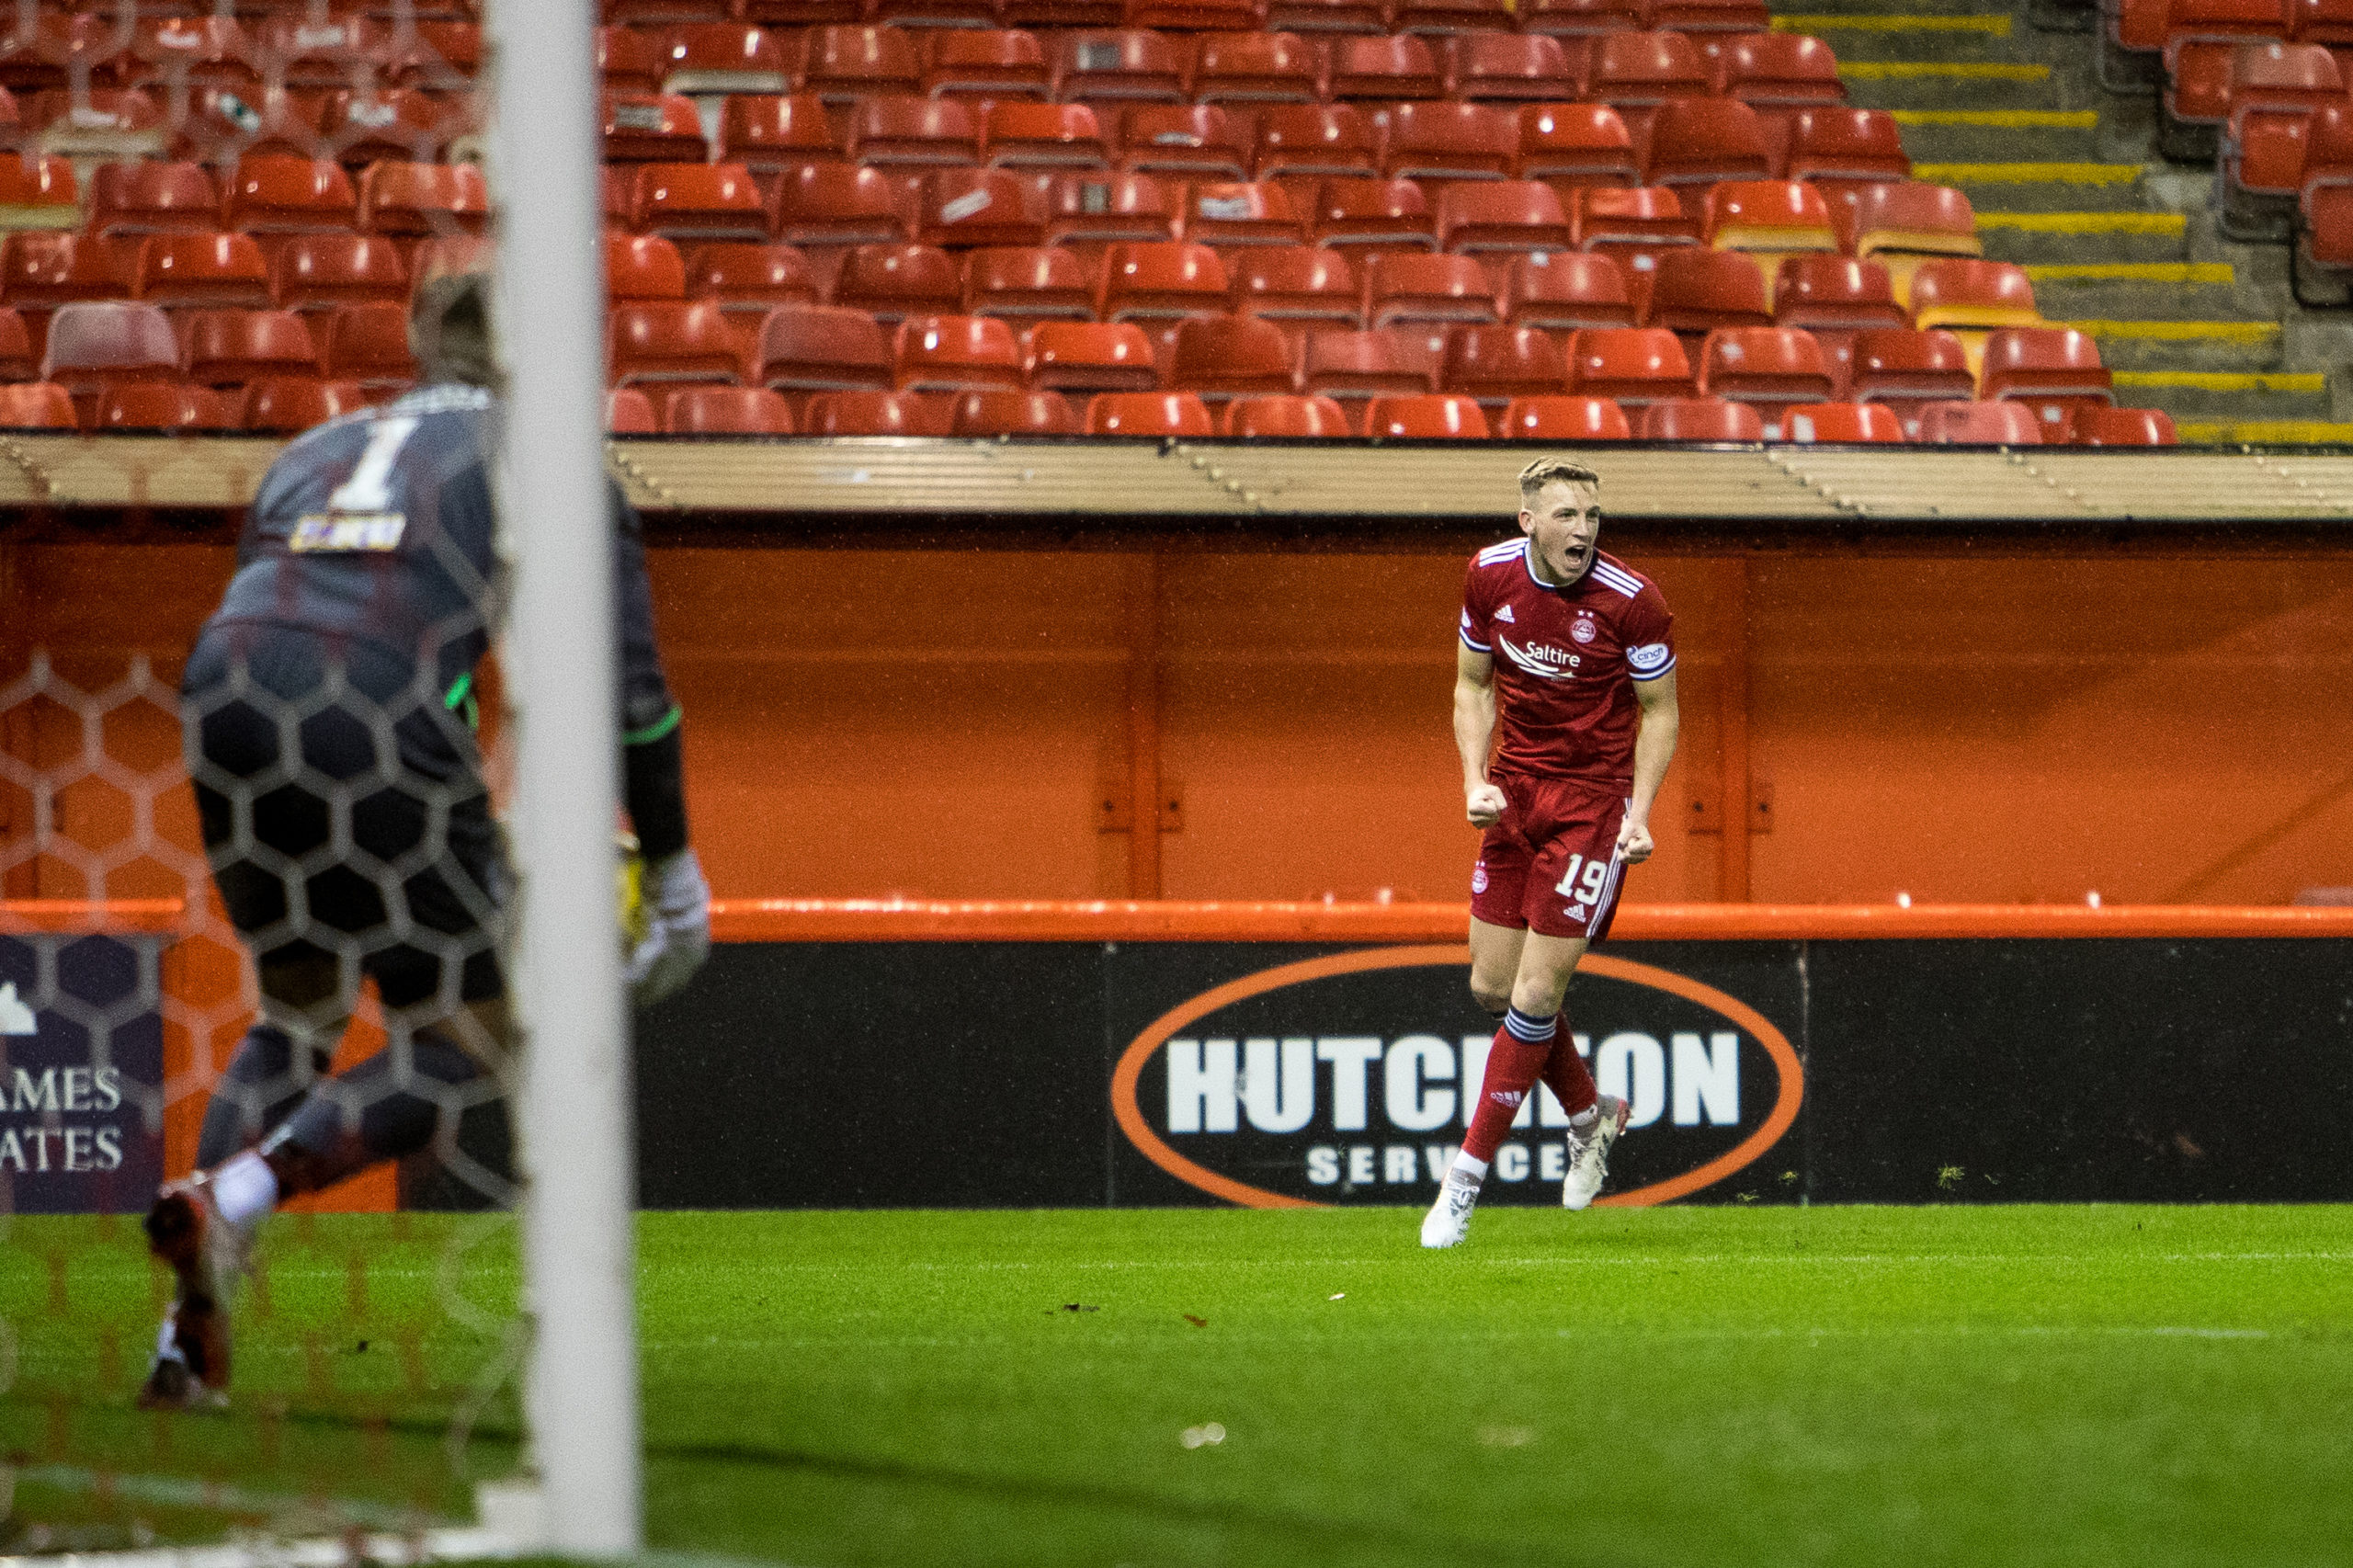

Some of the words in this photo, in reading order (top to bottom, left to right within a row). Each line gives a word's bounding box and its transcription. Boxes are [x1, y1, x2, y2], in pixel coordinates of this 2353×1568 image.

[328, 416, 419, 509] 1
[1526, 642, 1581, 667] Saltire
[1637, 647, 1664, 661] cinch
[1553, 853, 1608, 906] 19
[0, 1066, 122, 1112] MES
